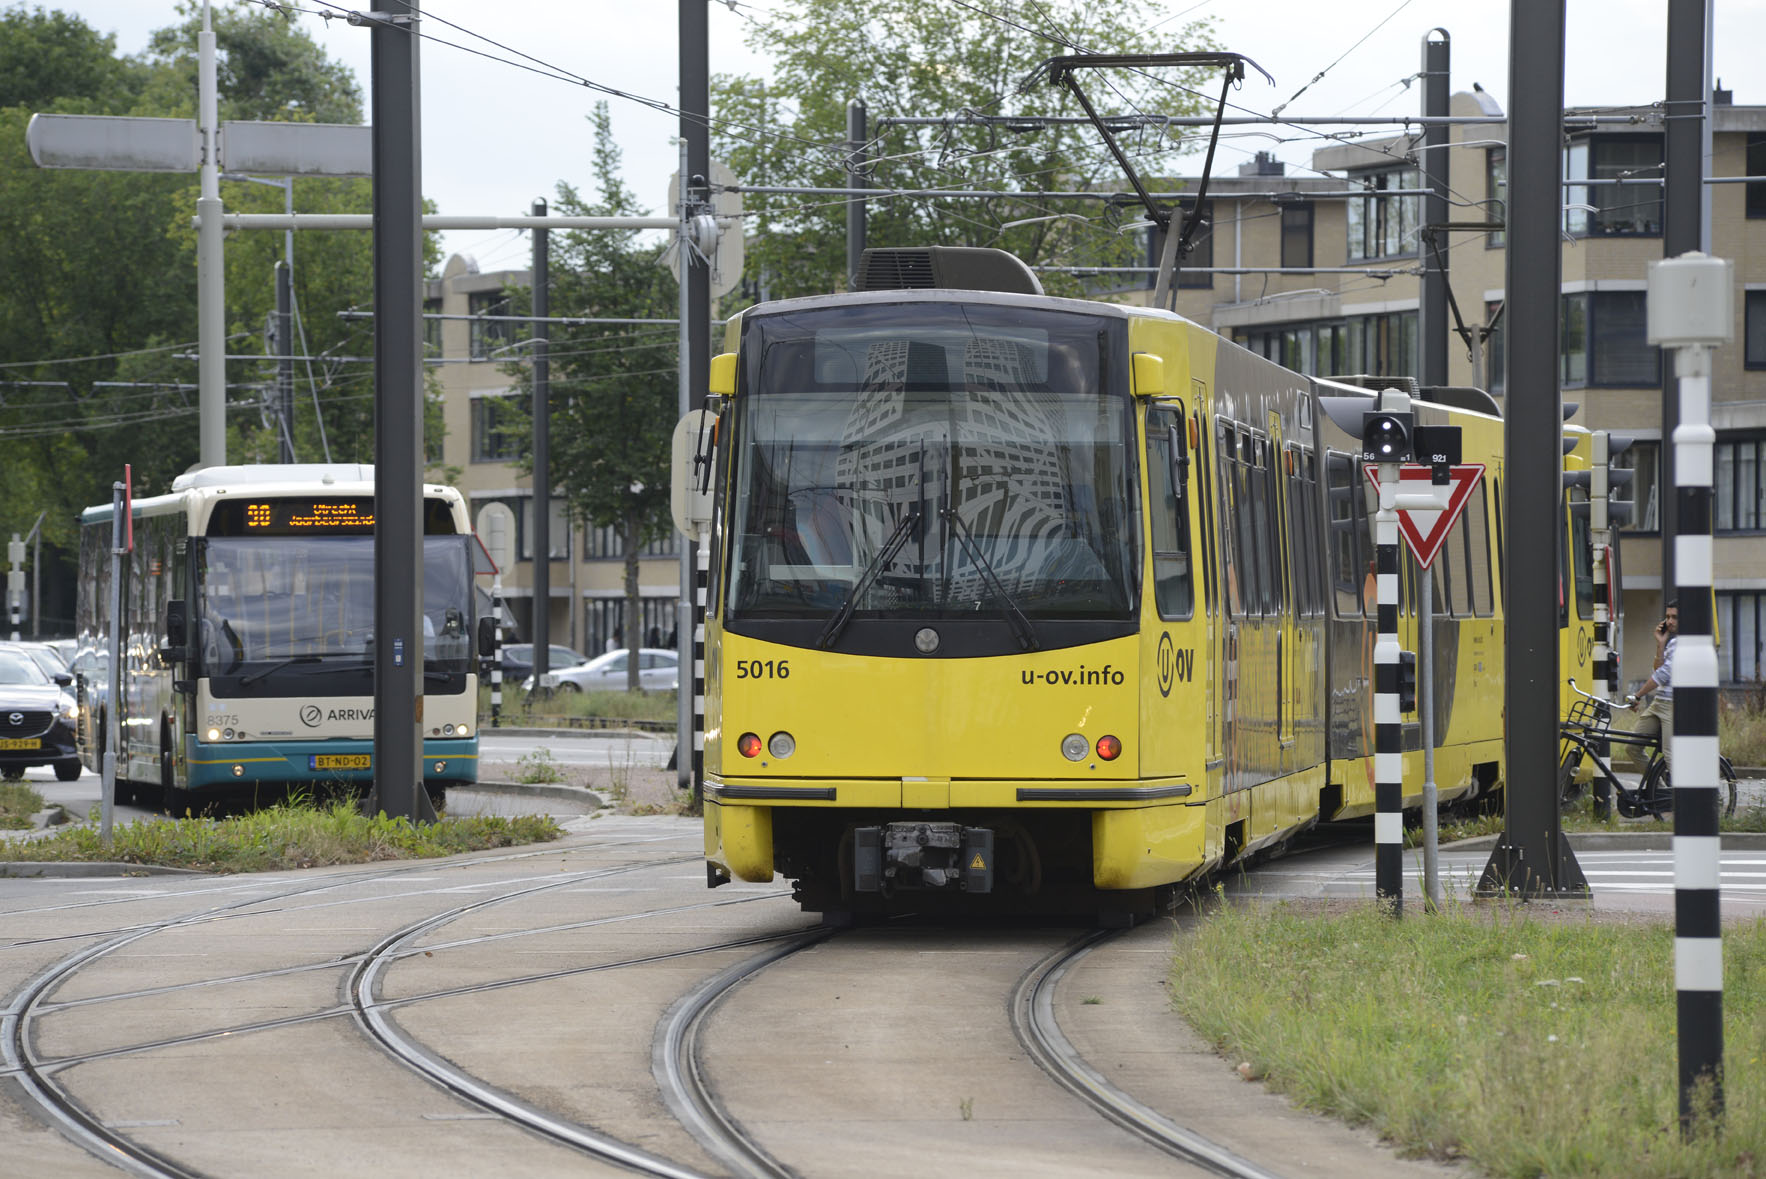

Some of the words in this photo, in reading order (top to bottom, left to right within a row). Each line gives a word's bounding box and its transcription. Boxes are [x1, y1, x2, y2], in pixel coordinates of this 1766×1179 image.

[1363, 452, 1375, 460] 56
[1432, 454, 1446, 462] 921
[313, 504, 356, 514] Utrecht
[248, 505, 270, 526] 90
[289, 515, 375, 526] Jaarbeurszijd
[974, 601, 981, 610] 7
[736, 660, 790, 679] 5016
[1021, 664, 1125, 685] u-ov.info
[207, 714, 239, 726] 8375
[327, 709, 376, 721] ARRIVA
[317, 757, 368, 768] BT-ND-02
